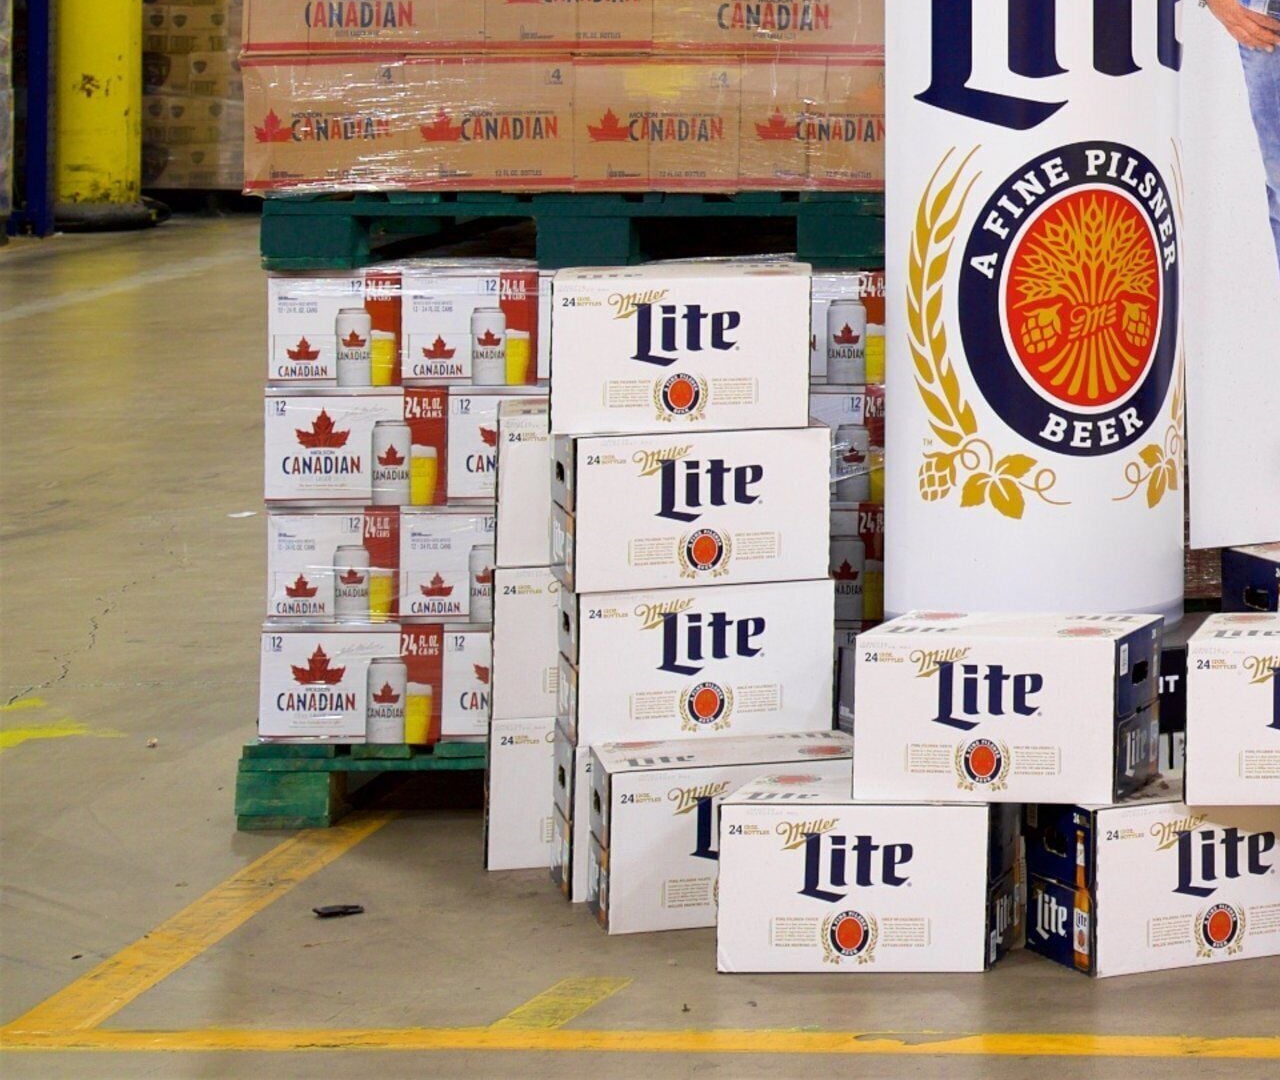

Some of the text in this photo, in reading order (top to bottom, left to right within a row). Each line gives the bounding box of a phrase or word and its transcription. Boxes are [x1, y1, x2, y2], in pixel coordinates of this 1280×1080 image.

[305, 1, 413, 28] CANADIAN
[717, 4, 831, 31] CANADIAN
[460, 115, 558, 141] CANADIAN
[629, 118, 723, 142] CANADIAN
[485, 280, 496, 291] 12
[562, 297, 576, 307] 24
[607, 288, 670, 320] Miller
[970, 148, 1177, 449] A FINE PILSNER BEER
[630, 304, 740, 367] Lite
[278, 365, 328, 377] CANADIAN
[413, 364, 463, 376] CANADIAN
[275, 401, 286, 412] 12
[405, 398, 421, 419] 24
[460, 400, 471, 411] 12
[282, 455, 361, 475] CANADIAN
[587, 456, 600, 465] 24
[632, 444, 694, 478] Miller
[655, 459, 763, 521] Lite
[276, 602, 325, 614] CANADIAN
[411, 601, 461, 613] CANADIAN
[589, 609, 602, 619] 24
[634, 597, 695, 632] Miller
[272, 636, 282, 648] 12
[402, 634, 417, 655] 24
[656, 612, 766, 676] Lite
[865, 652, 878, 662] 24
[909, 647, 972, 678] Miller
[1197, 660, 1211, 670] 24
[277, 693, 356, 712] CANADIAN
[931, 661, 1043, 731] Lite
[620, 794, 634, 804] 24
[667, 781, 732, 816] Miller
[729, 825, 743, 835] 24
[776, 818, 840, 851] Miller
[1106, 830, 1119, 840] 24
[1150, 814, 1207, 851] Miller
[797, 833, 913, 903] Lite
[1172, 828, 1275, 897] Lite
[1035, 889, 1067, 939] Lite
